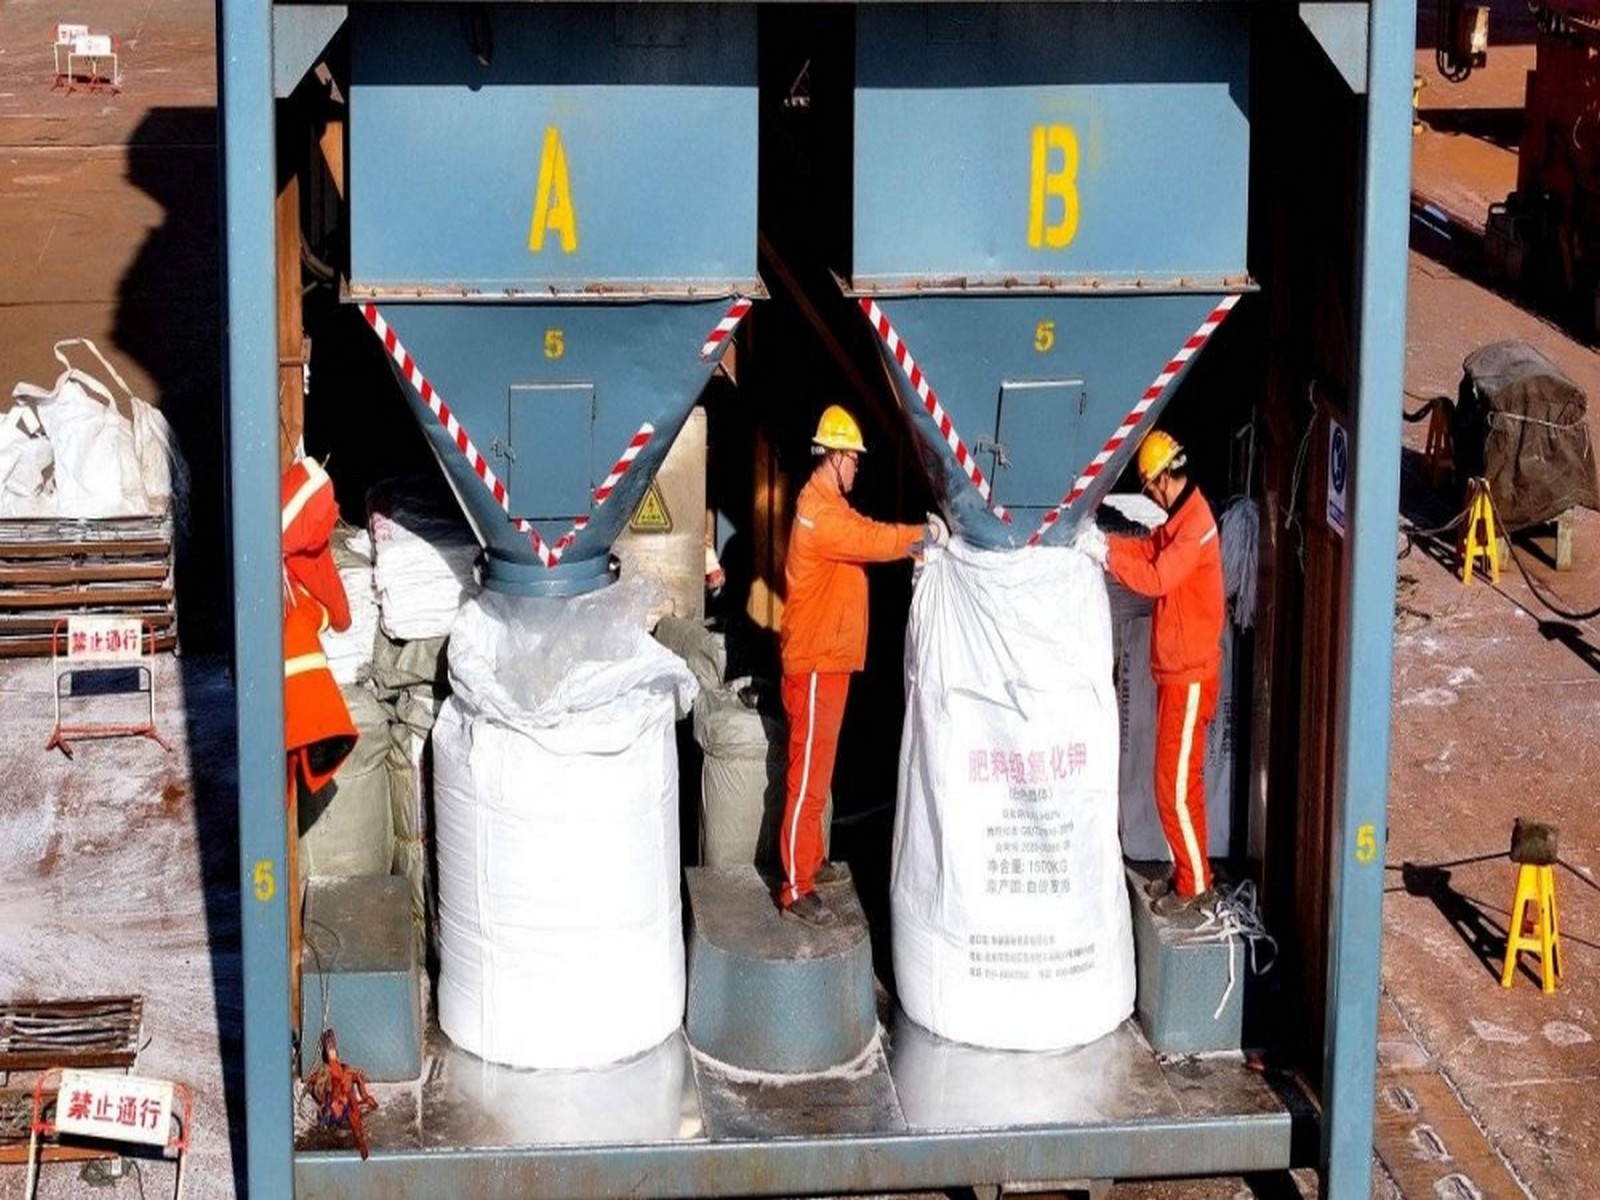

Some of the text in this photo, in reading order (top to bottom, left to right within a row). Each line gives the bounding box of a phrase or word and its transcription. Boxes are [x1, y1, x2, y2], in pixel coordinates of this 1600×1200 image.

[527, 124, 579, 254] A
[1026, 122, 1081, 250] B
[543, 328, 565, 359] 5
[1034, 321, 1056, 352] 5
[72, 629, 138, 654] 禁止通行
[1356, 823, 1377, 863] 5
[253, 859, 276, 902] 5
[67, 1090, 162, 1130] 禁止通行
